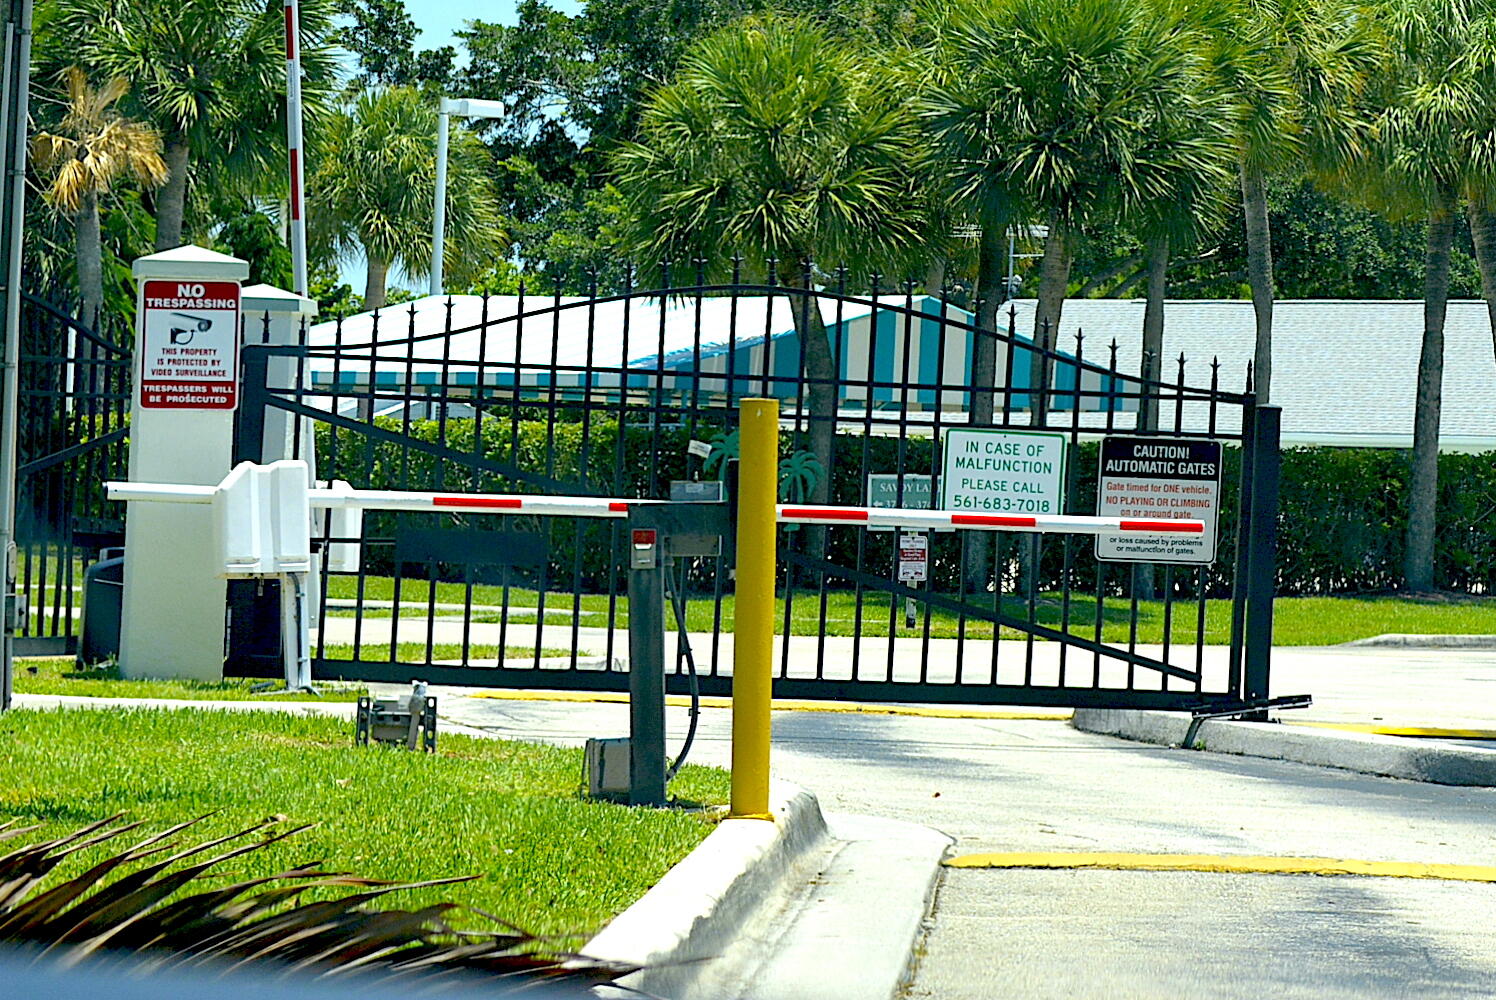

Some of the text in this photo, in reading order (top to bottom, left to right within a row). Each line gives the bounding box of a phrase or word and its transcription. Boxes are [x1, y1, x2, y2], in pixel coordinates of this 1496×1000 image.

[177, 284, 205, 297] NO
[146, 298, 236, 309] TRESPASSING
[181, 348, 217, 356] PROPERTY
[158, 358, 164, 366] IS
[176, 369, 227, 377] SURVEILLANCE
[143, 385, 207, 393] TRESPASSERS
[149, 395, 228, 403] BE PROSECUTED
[966, 441, 1045, 457] IN CASE OF
[1134, 445, 1190, 459] CAUTION!
[956, 457, 1052, 474] MALFUNCTION
[1106, 460, 1215, 476] AUTOMATIC GATES
[962, 478, 1044, 494] PLEASE CALL
[1107, 482, 1212, 495] Gate timed for ONE vehicle.
[954, 495, 1050, 512] 561-683-7018
[1106, 496, 1210, 508] NO PLAYING OR CLIMBING
[1144, 510, 1172, 518] around
[1135, 537, 1160, 545] caused
[1161, 538, 1169, 546] by
[1171, 538, 1203, 546] problems
